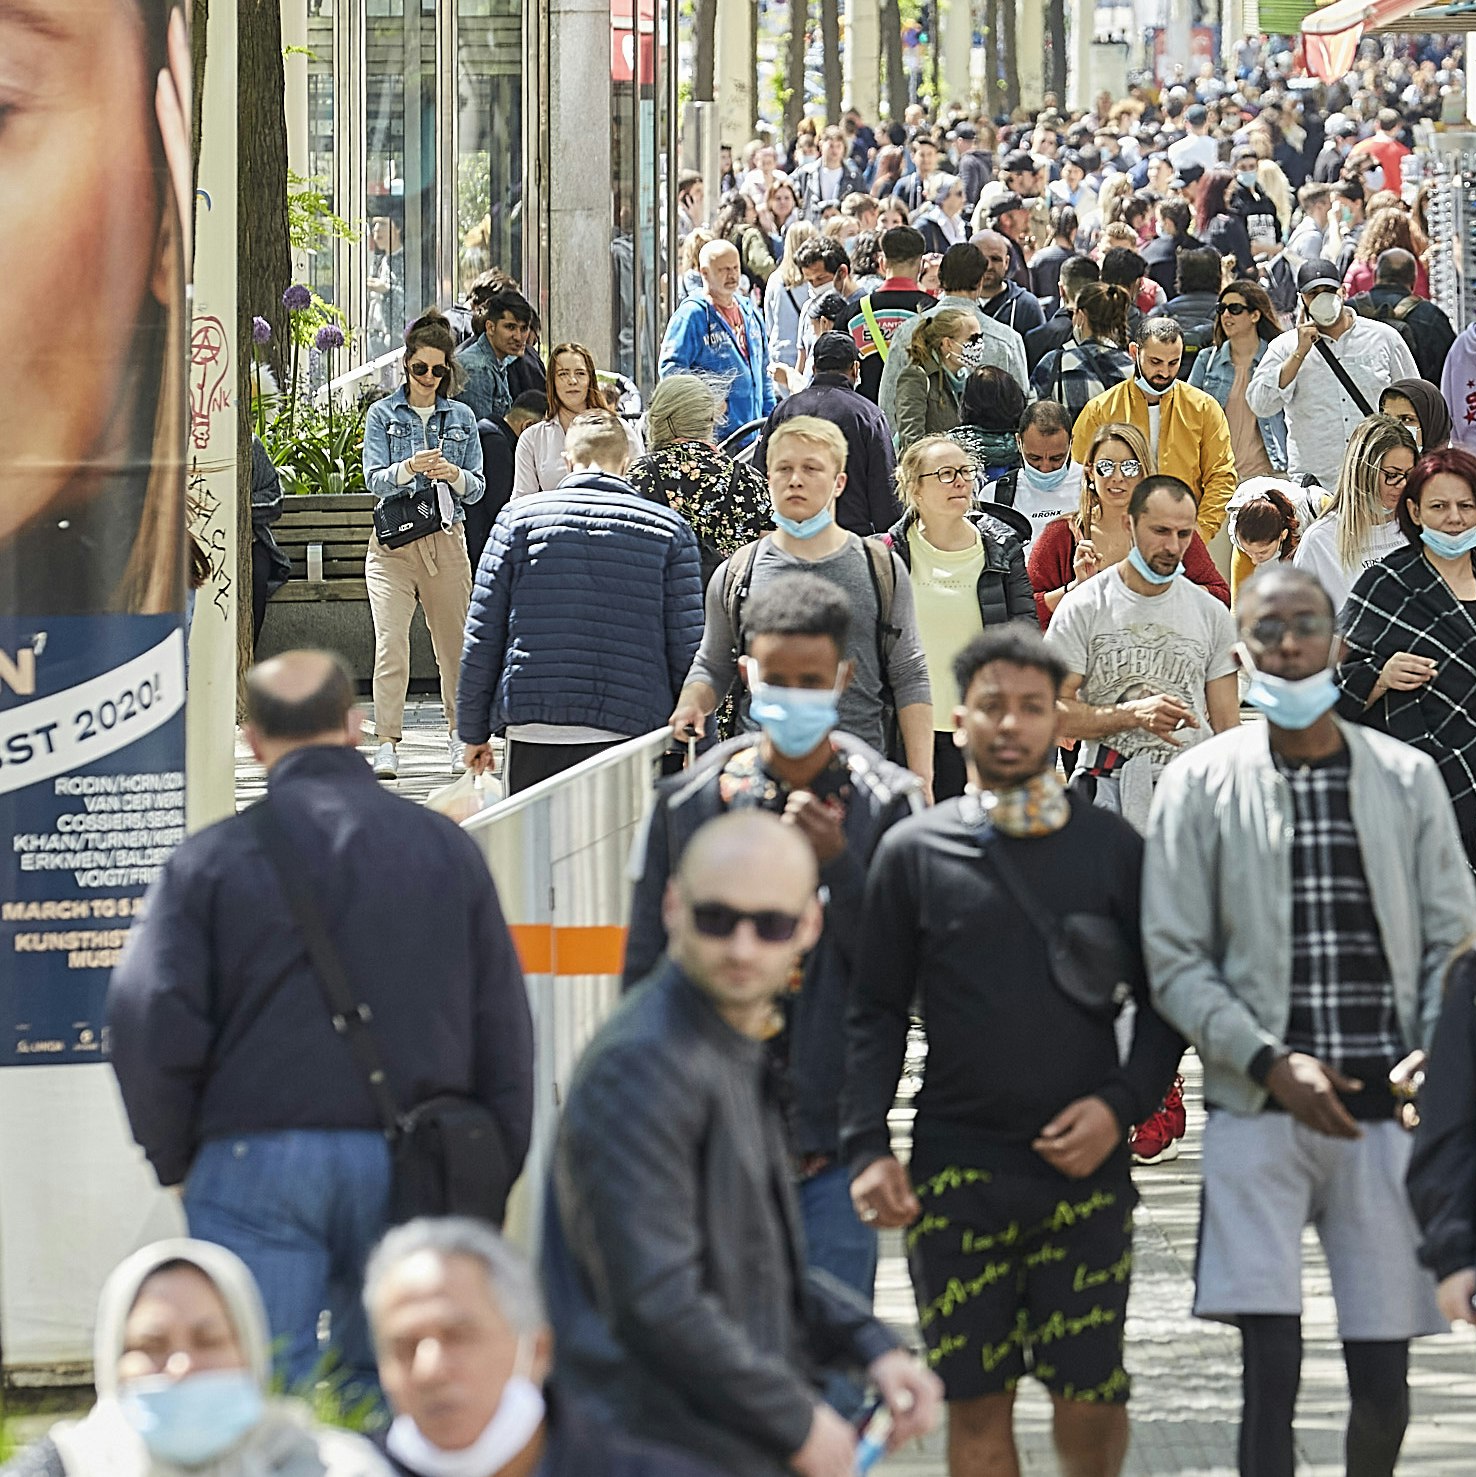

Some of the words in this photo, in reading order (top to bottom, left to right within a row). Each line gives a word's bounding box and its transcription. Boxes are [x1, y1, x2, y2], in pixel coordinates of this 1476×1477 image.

[0, 722, 57, 768] ST
[75, 672, 163, 742] 2020!
[84, 795, 121, 812] VAN
[2, 901, 89, 921] MARCH
